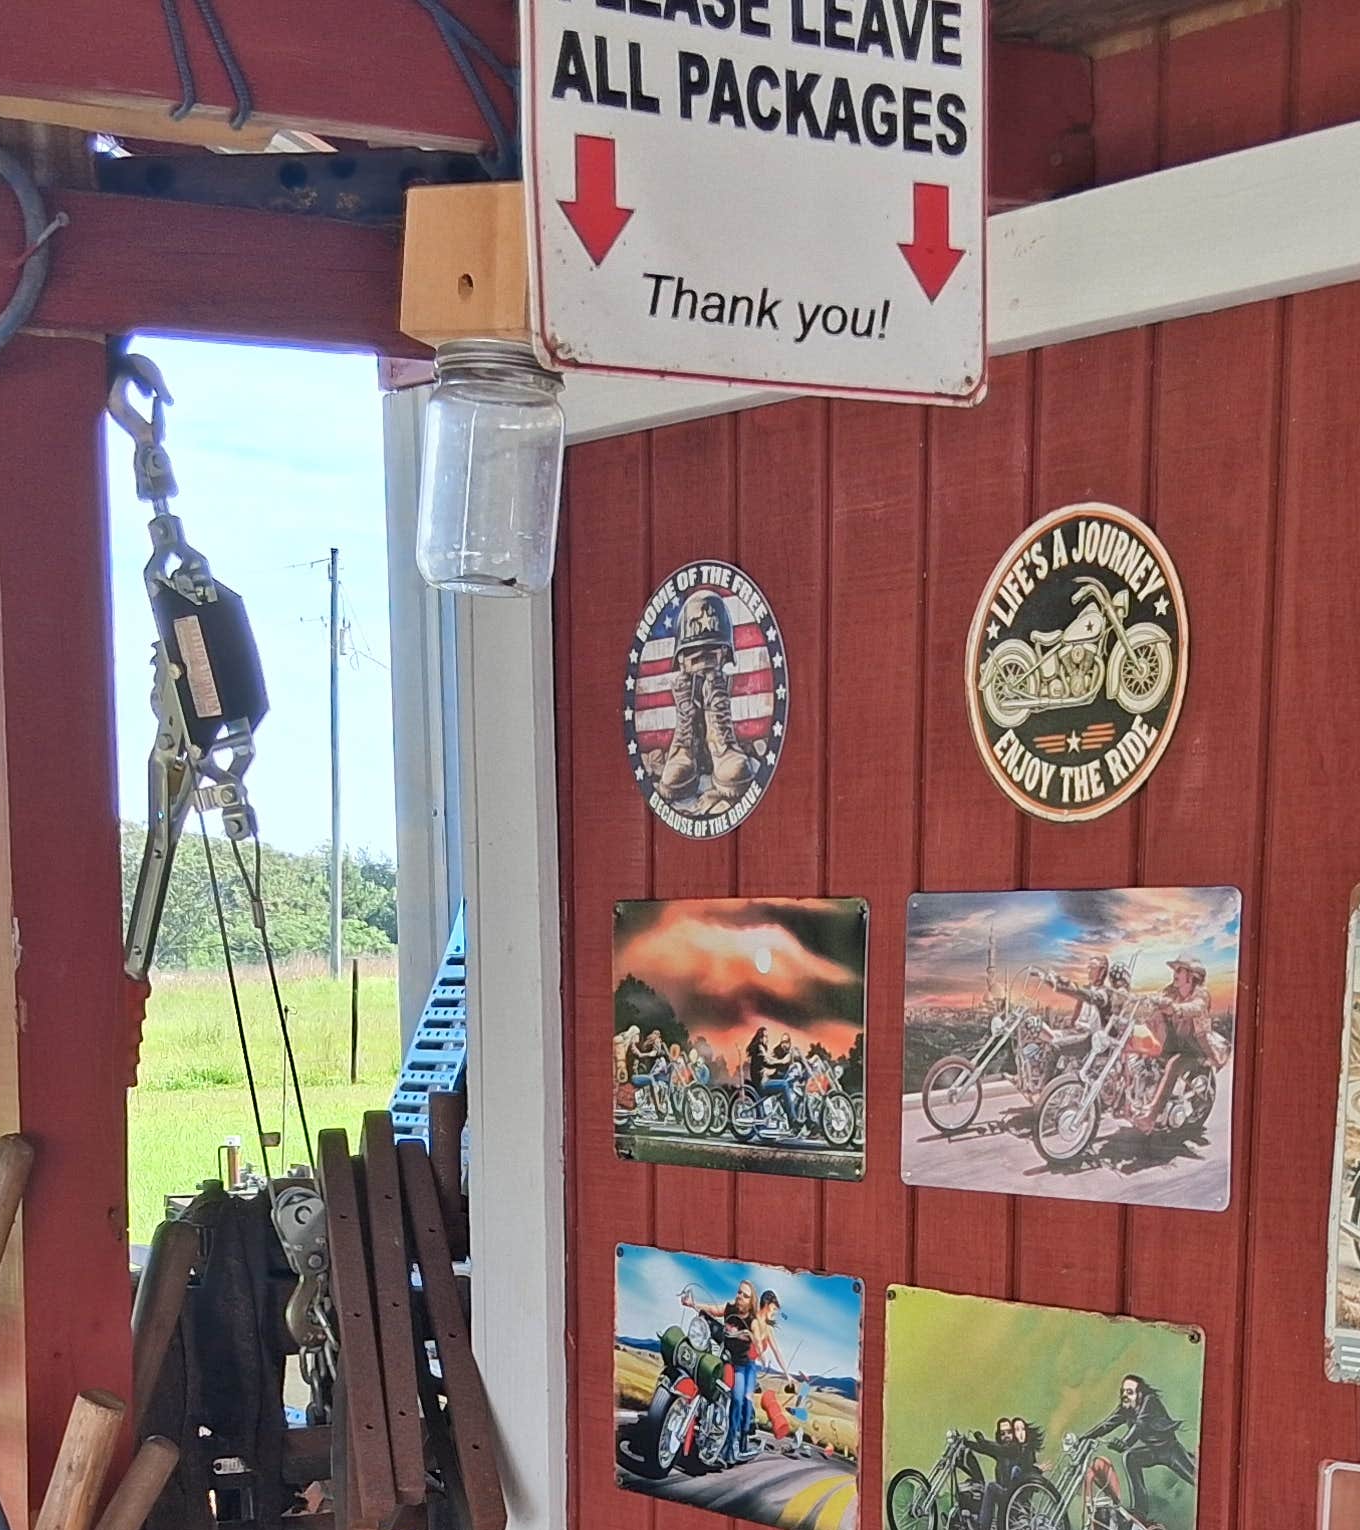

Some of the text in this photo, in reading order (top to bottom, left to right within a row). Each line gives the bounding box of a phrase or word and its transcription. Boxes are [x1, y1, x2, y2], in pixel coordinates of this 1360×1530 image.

[791, 0, 962, 66] LEAVE
[552, 30, 967, 156] ALL PACKAGES
[643, 273, 890, 344] Thank you!
[636, 565, 768, 642] HOME OF THE FREE
[991, 520, 1165, 627] LIFE'S A JOURNEY
[992, 714, 1159, 802] ENJOY THE RIDE
[649, 780, 762, 837] BECAUSE OF THE BRAVE
